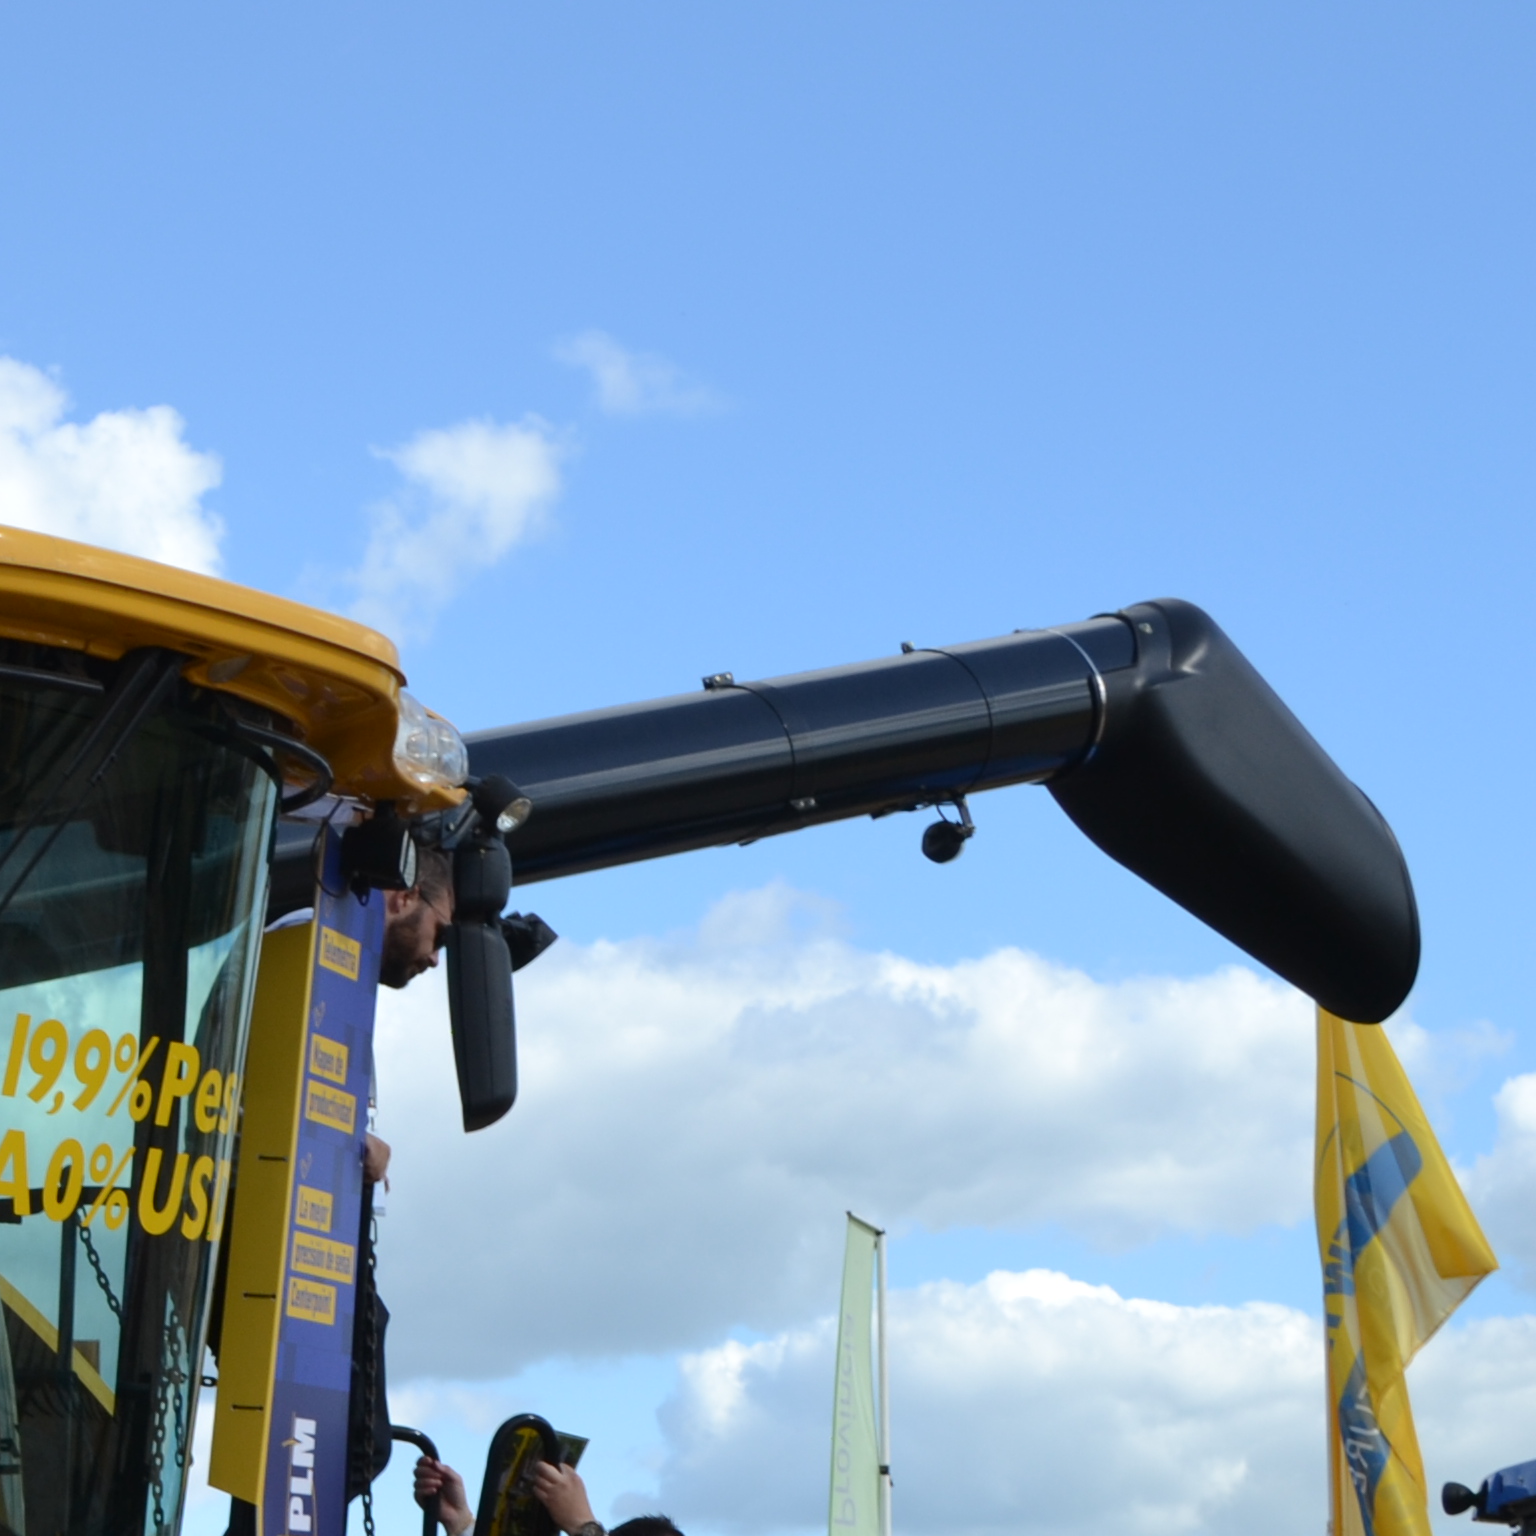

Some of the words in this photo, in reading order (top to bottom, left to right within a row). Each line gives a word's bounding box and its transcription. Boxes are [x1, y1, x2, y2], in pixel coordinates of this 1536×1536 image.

[1, 1012, 161, 1124] 19,9%
[42, 1137, 136, 1232] 0%
[288, 1416, 317, 1533] PLM
